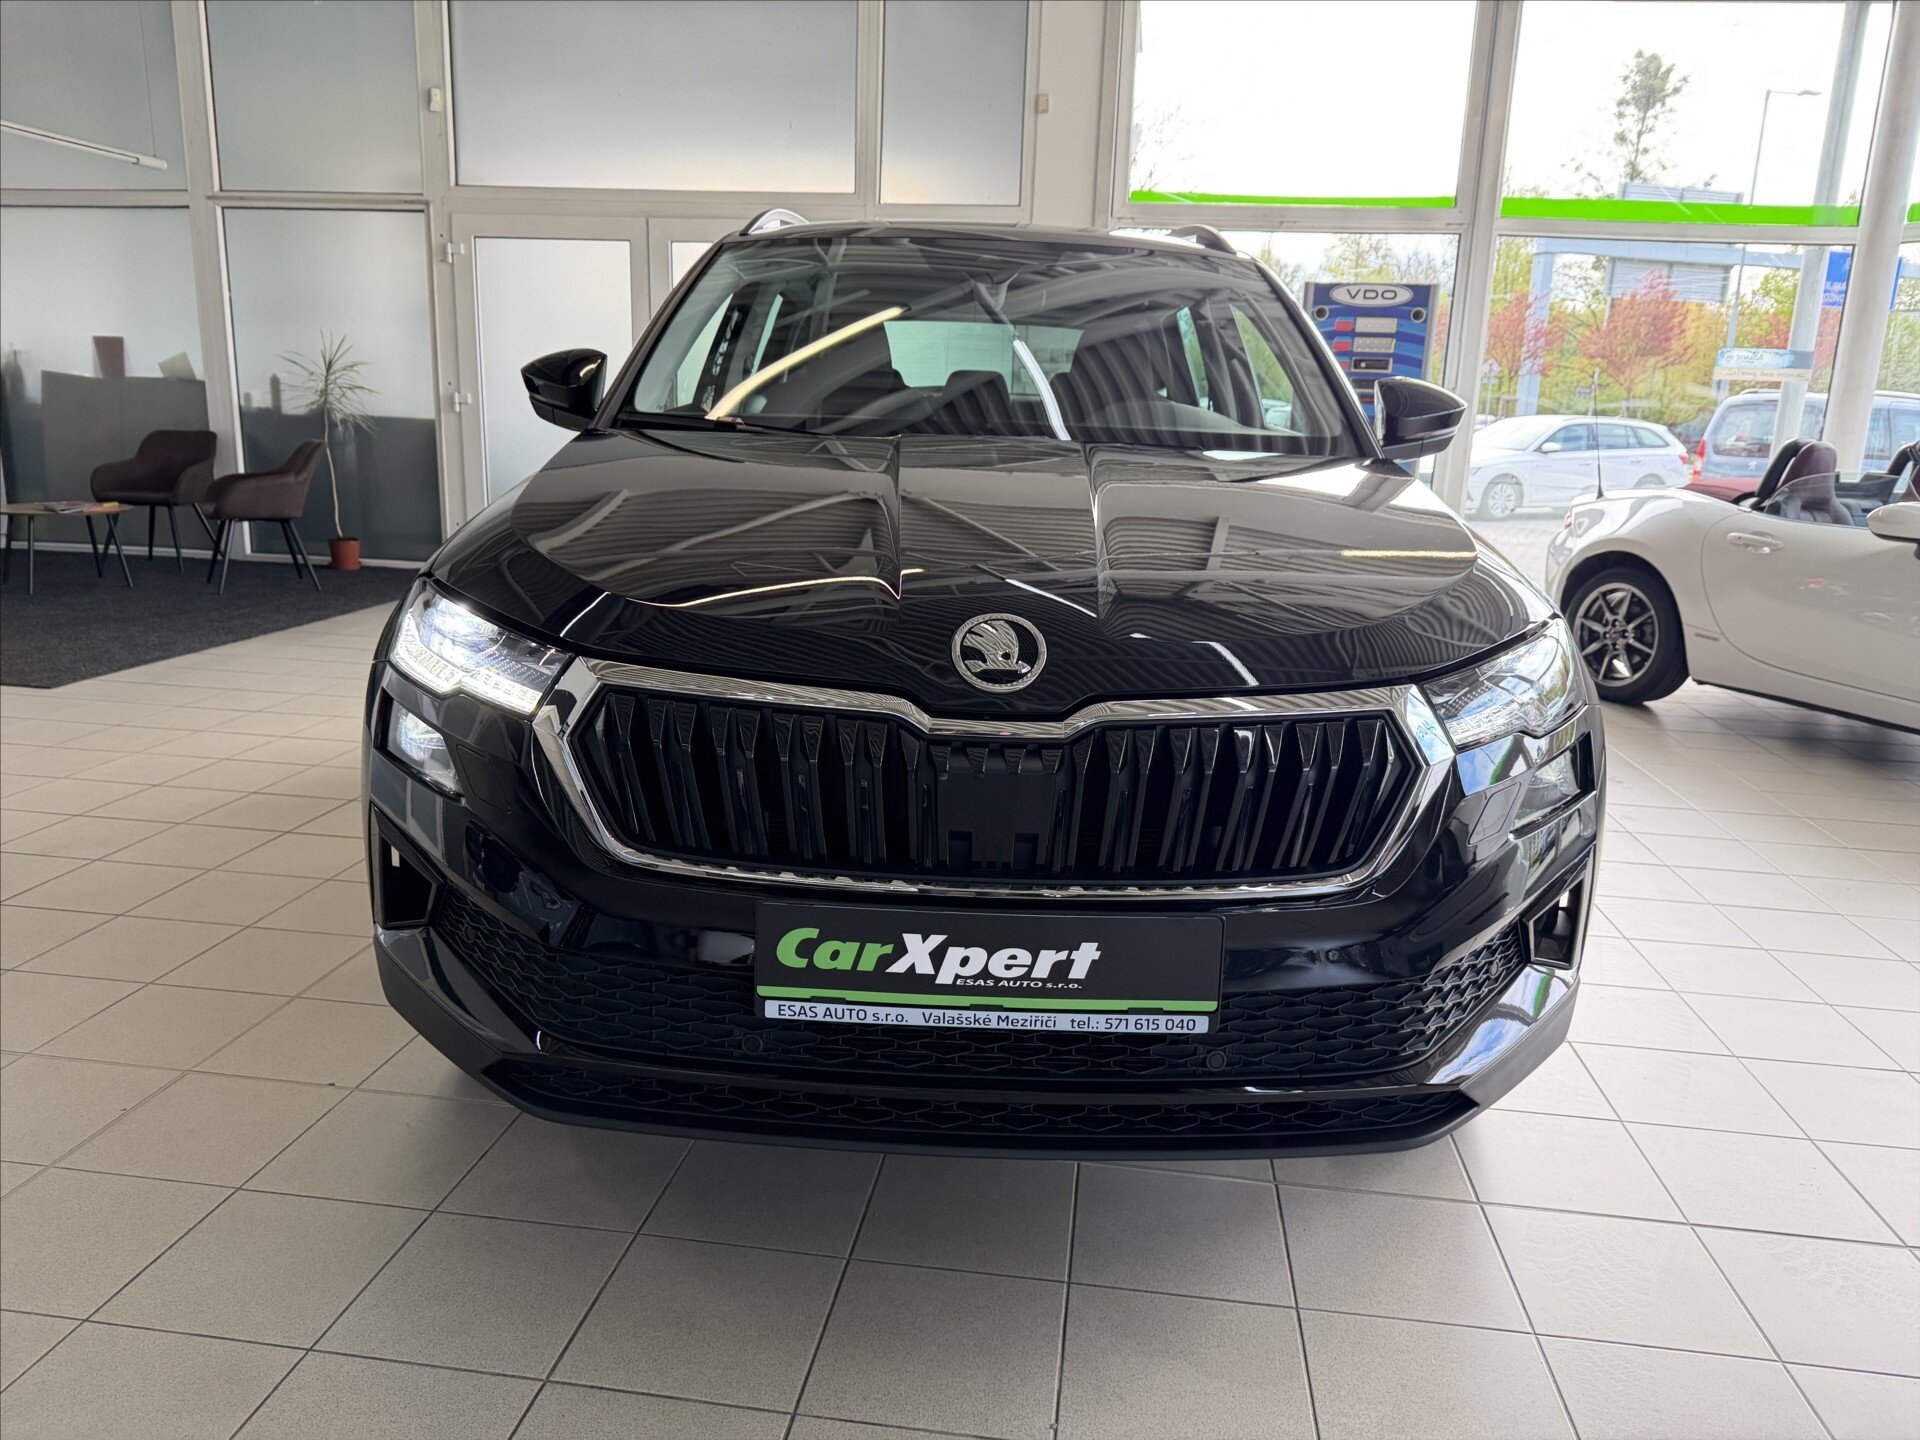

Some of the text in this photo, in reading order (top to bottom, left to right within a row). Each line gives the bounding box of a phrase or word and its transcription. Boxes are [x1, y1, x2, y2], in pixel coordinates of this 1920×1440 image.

[1346, 289, 1398, 300] VDO
[776, 927, 1102, 985] CarXpert
[956, 978, 995, 987] ESAS
[997, 980, 1043, 988] AUTO
[777, 1003, 1197, 1032] ESAS AUTO s.r.o. Valašské Meziříčí tel.: 571 615 040
